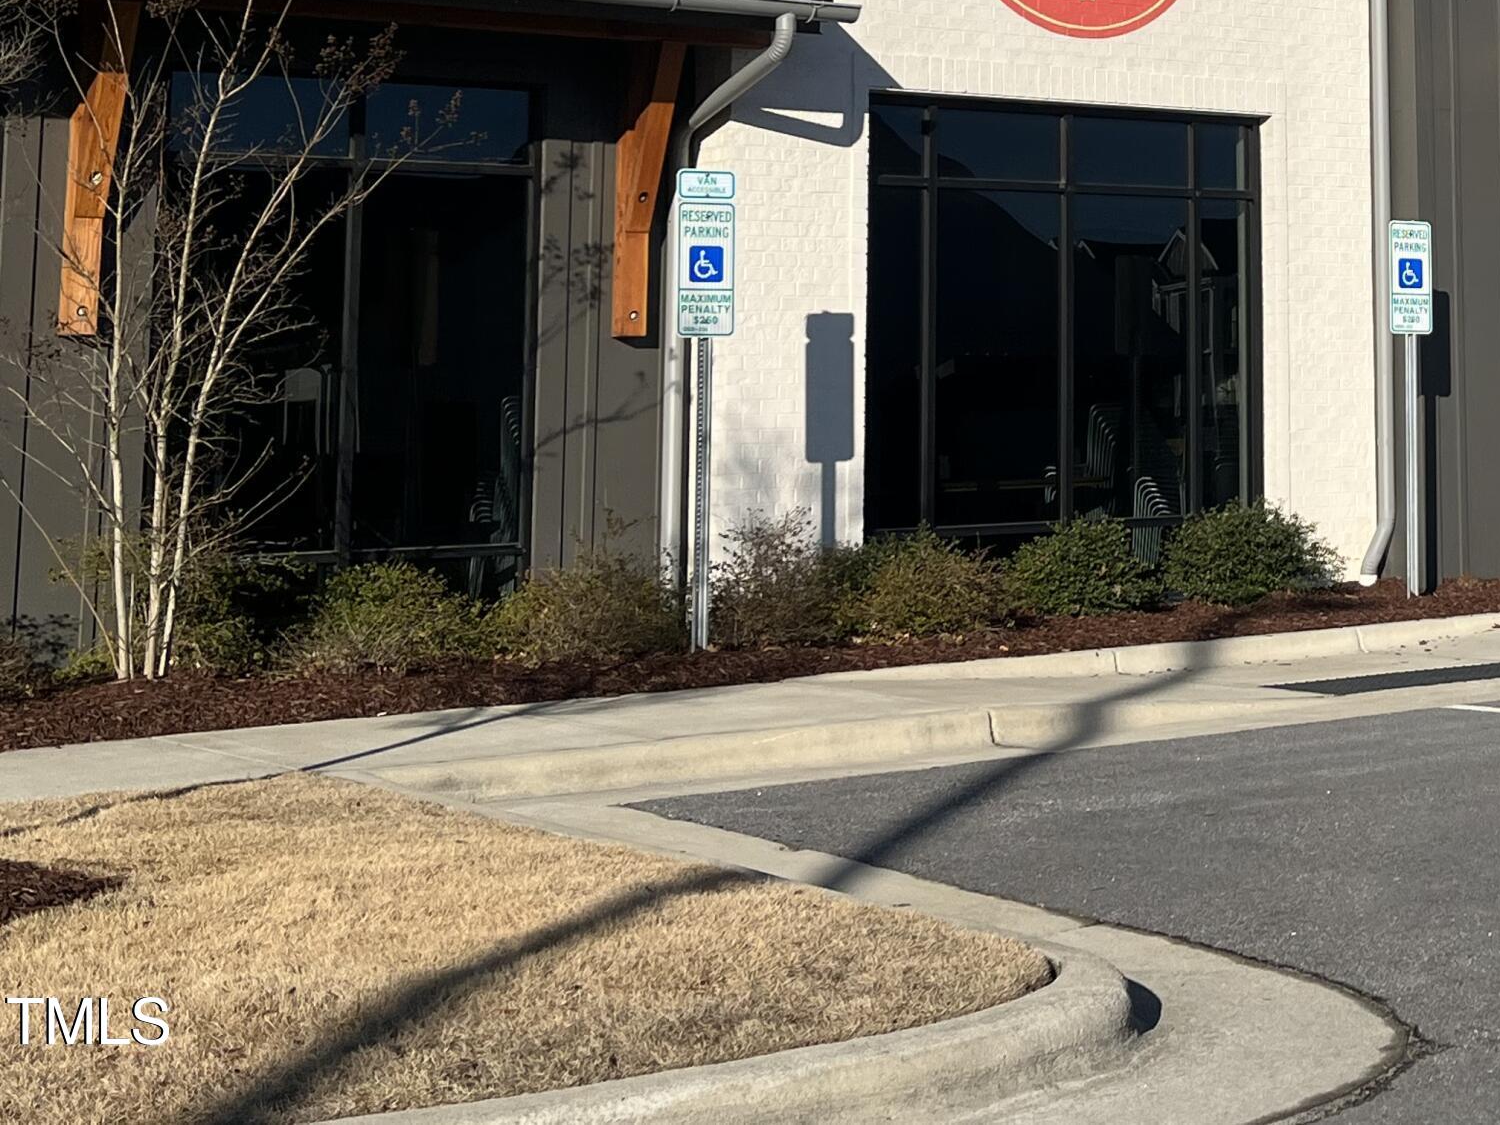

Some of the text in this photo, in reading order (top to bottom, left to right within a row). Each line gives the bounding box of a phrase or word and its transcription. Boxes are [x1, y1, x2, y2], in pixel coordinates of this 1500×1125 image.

[697, 176, 718, 186] VAN
[681, 210, 732, 223] RESERVED
[684, 226, 729, 238] PARKING
[1392, 228, 1428, 240] RESERVED
[1394, 241, 1427, 253] PARKING
[681, 294, 731, 303] MAXIMUM
[681, 304, 731, 314] PENALTY
[1394, 306, 1428, 315] PENALTY
